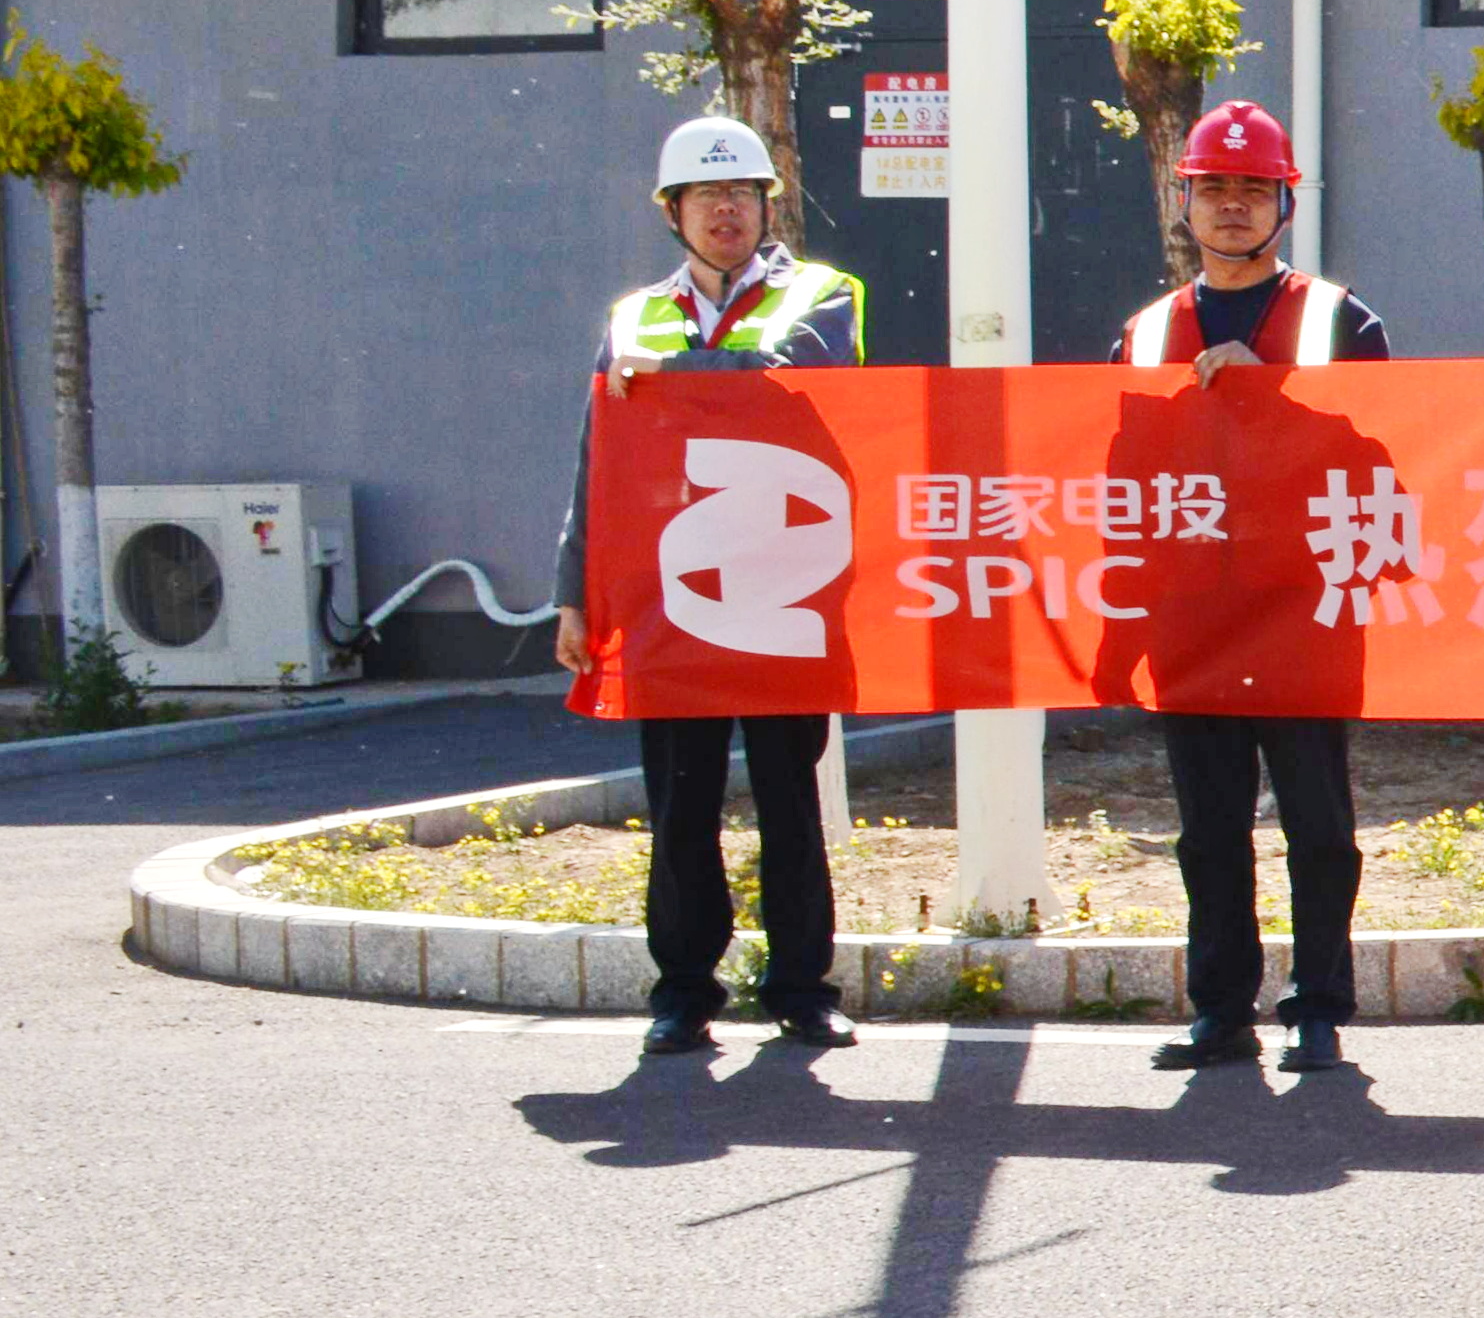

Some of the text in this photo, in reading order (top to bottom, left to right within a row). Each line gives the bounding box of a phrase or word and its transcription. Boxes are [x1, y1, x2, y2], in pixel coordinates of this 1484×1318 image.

[888, 77, 937, 90] 配电房
[896, 472, 1229, 543] 国家电投
[895, 555, 1150, 621] SPIC
